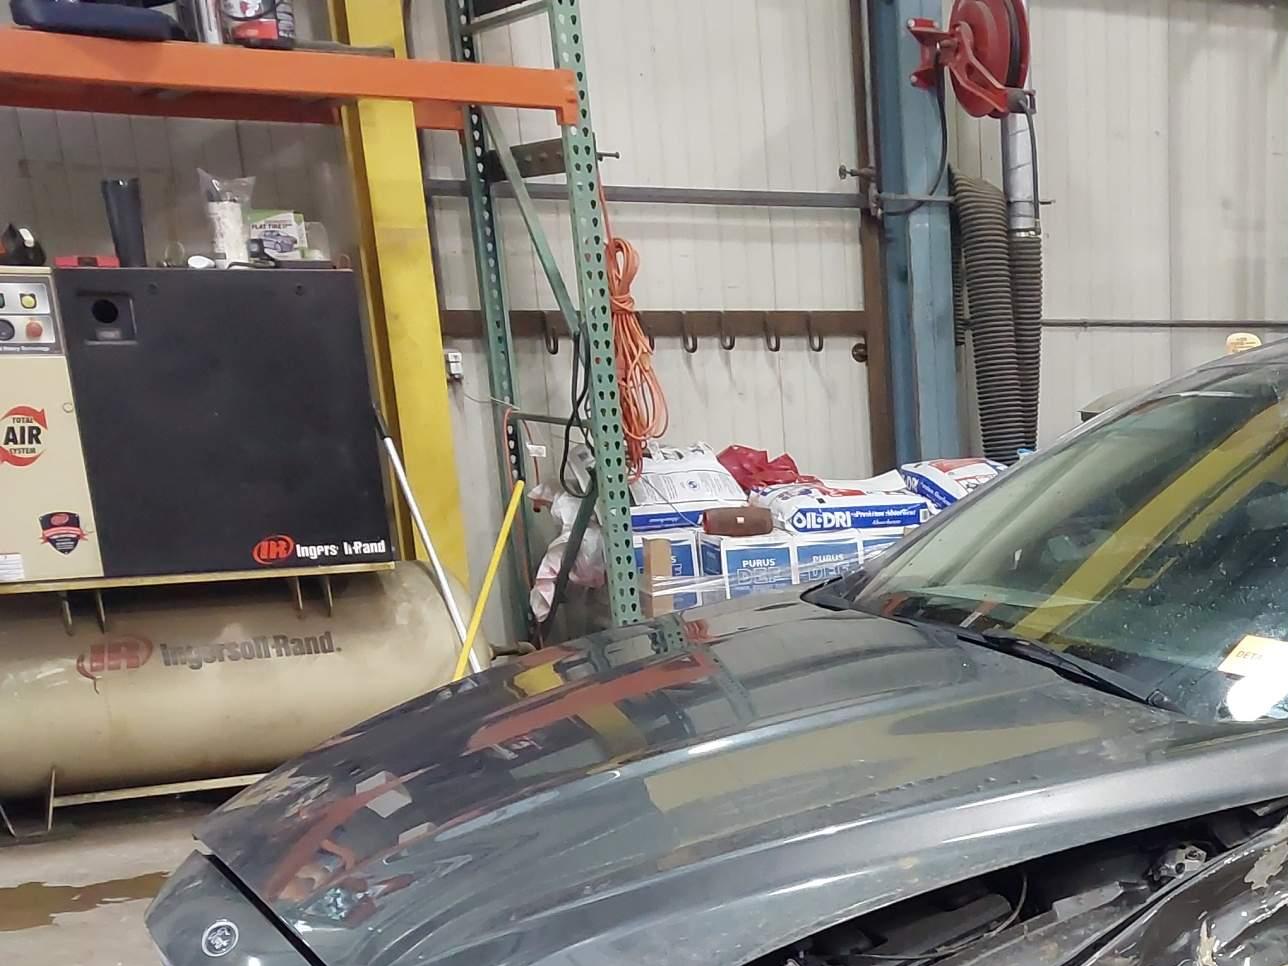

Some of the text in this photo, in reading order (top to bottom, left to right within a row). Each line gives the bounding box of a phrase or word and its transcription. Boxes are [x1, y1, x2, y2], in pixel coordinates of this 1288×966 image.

[12, 416, 34, 424] TOTAL
[3, 425, 42, 446] AIR
[9, 447, 37, 455] SYSTEM
[742, 558, 776, 568] PURUS
